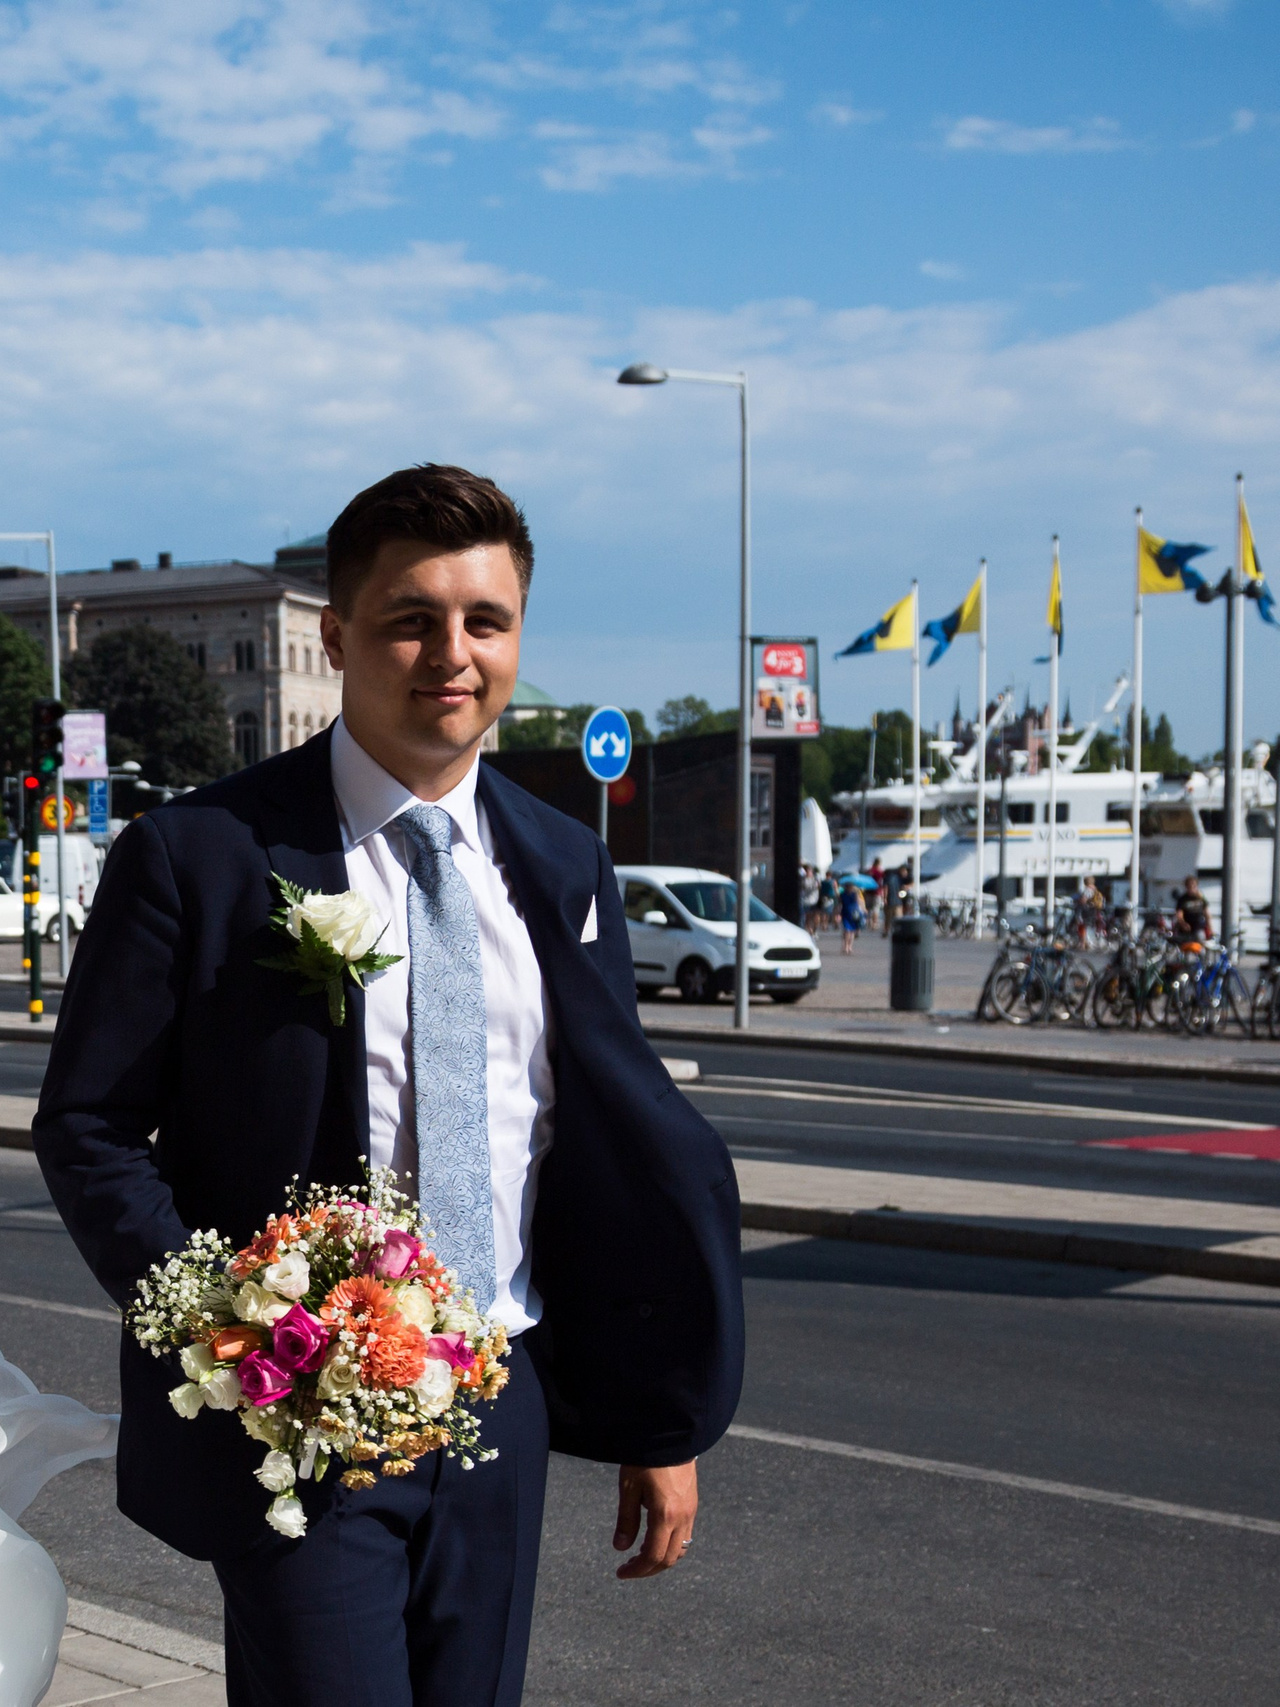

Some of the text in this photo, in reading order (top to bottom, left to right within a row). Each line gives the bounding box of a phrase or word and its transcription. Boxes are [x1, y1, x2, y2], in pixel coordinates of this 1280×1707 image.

[766, 650, 777, 666] 4
[792, 656, 804, 674] 3
[94, 780, 105, 794] P
